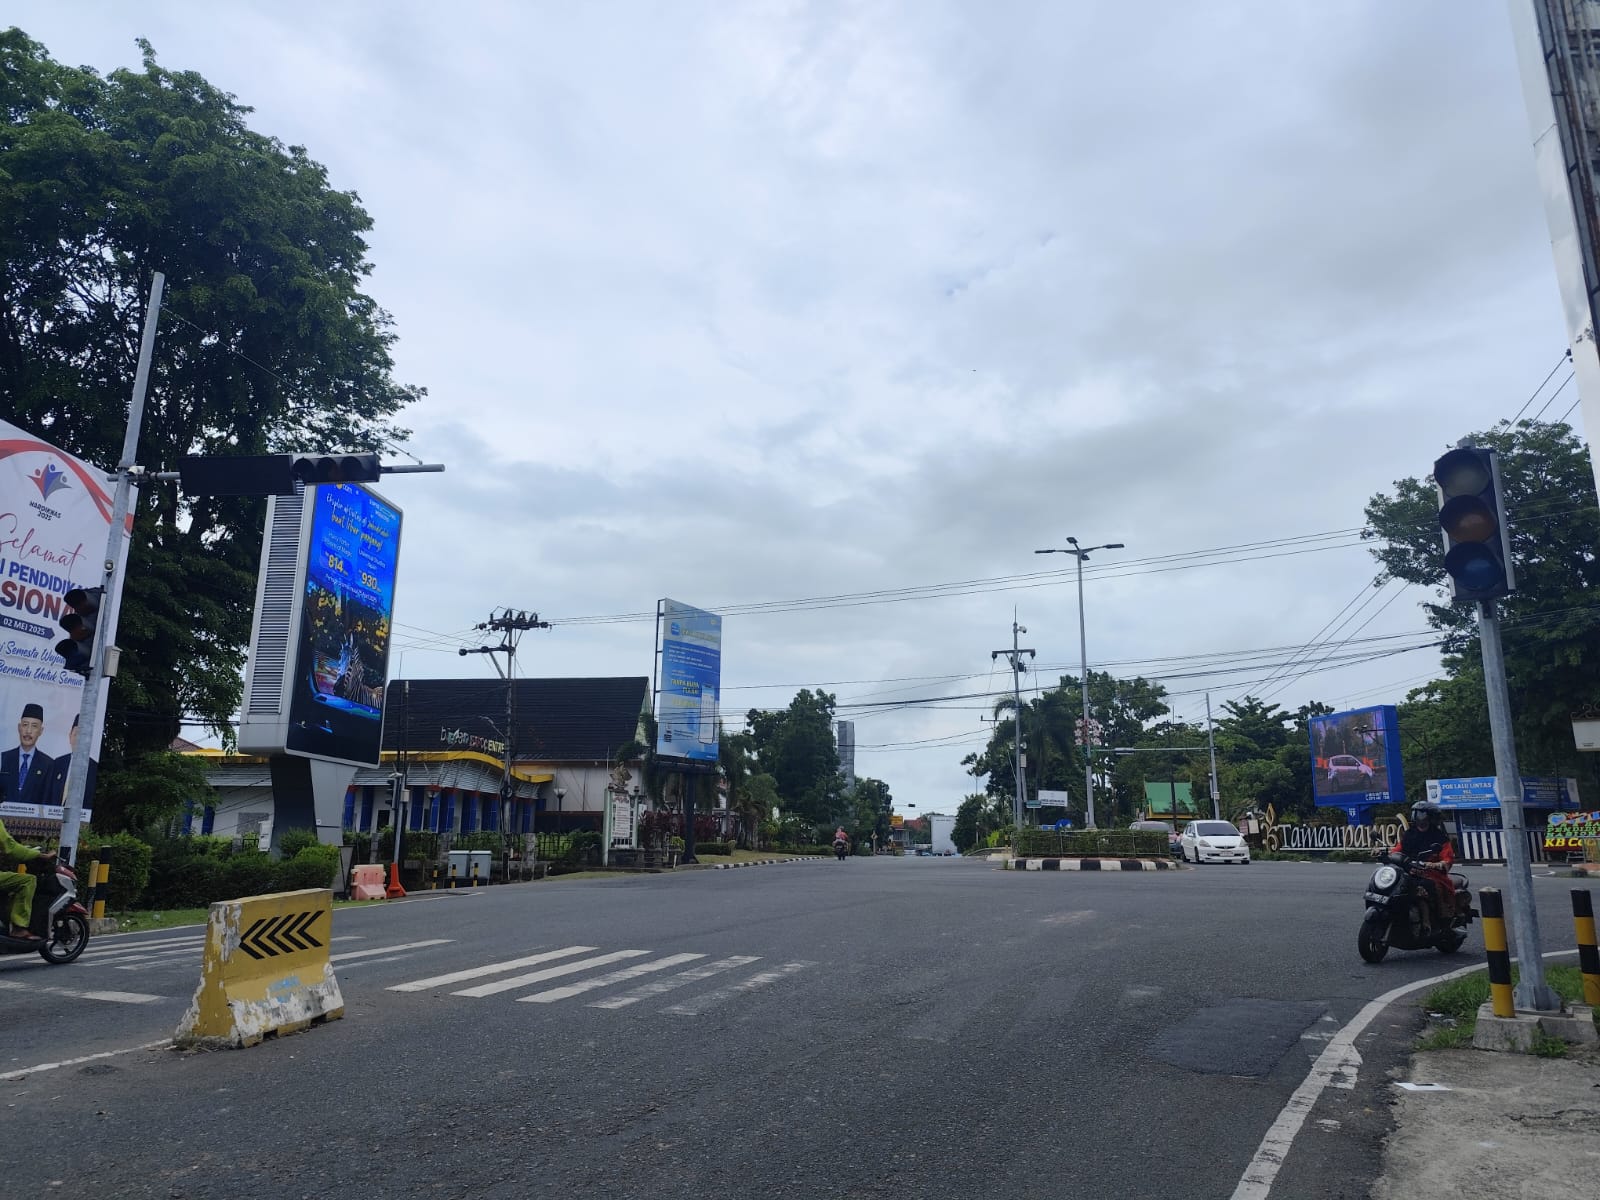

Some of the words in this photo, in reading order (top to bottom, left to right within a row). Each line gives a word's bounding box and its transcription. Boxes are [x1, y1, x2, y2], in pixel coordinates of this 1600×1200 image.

[37, 510, 52, 521] 2025
[328, 554, 344, 573] 814
[9, 561, 84, 595] PENDIDIK
[361, 572, 378, 590] 930
[3, 617, 14, 628] 02
[13, 620, 28, 632] MEI
[28, 624, 46, 636] 2025
[6, 640, 39, 659] Semesta
[33, 667, 58, 682] Untuk
[59, 670, 83, 687] Semua
